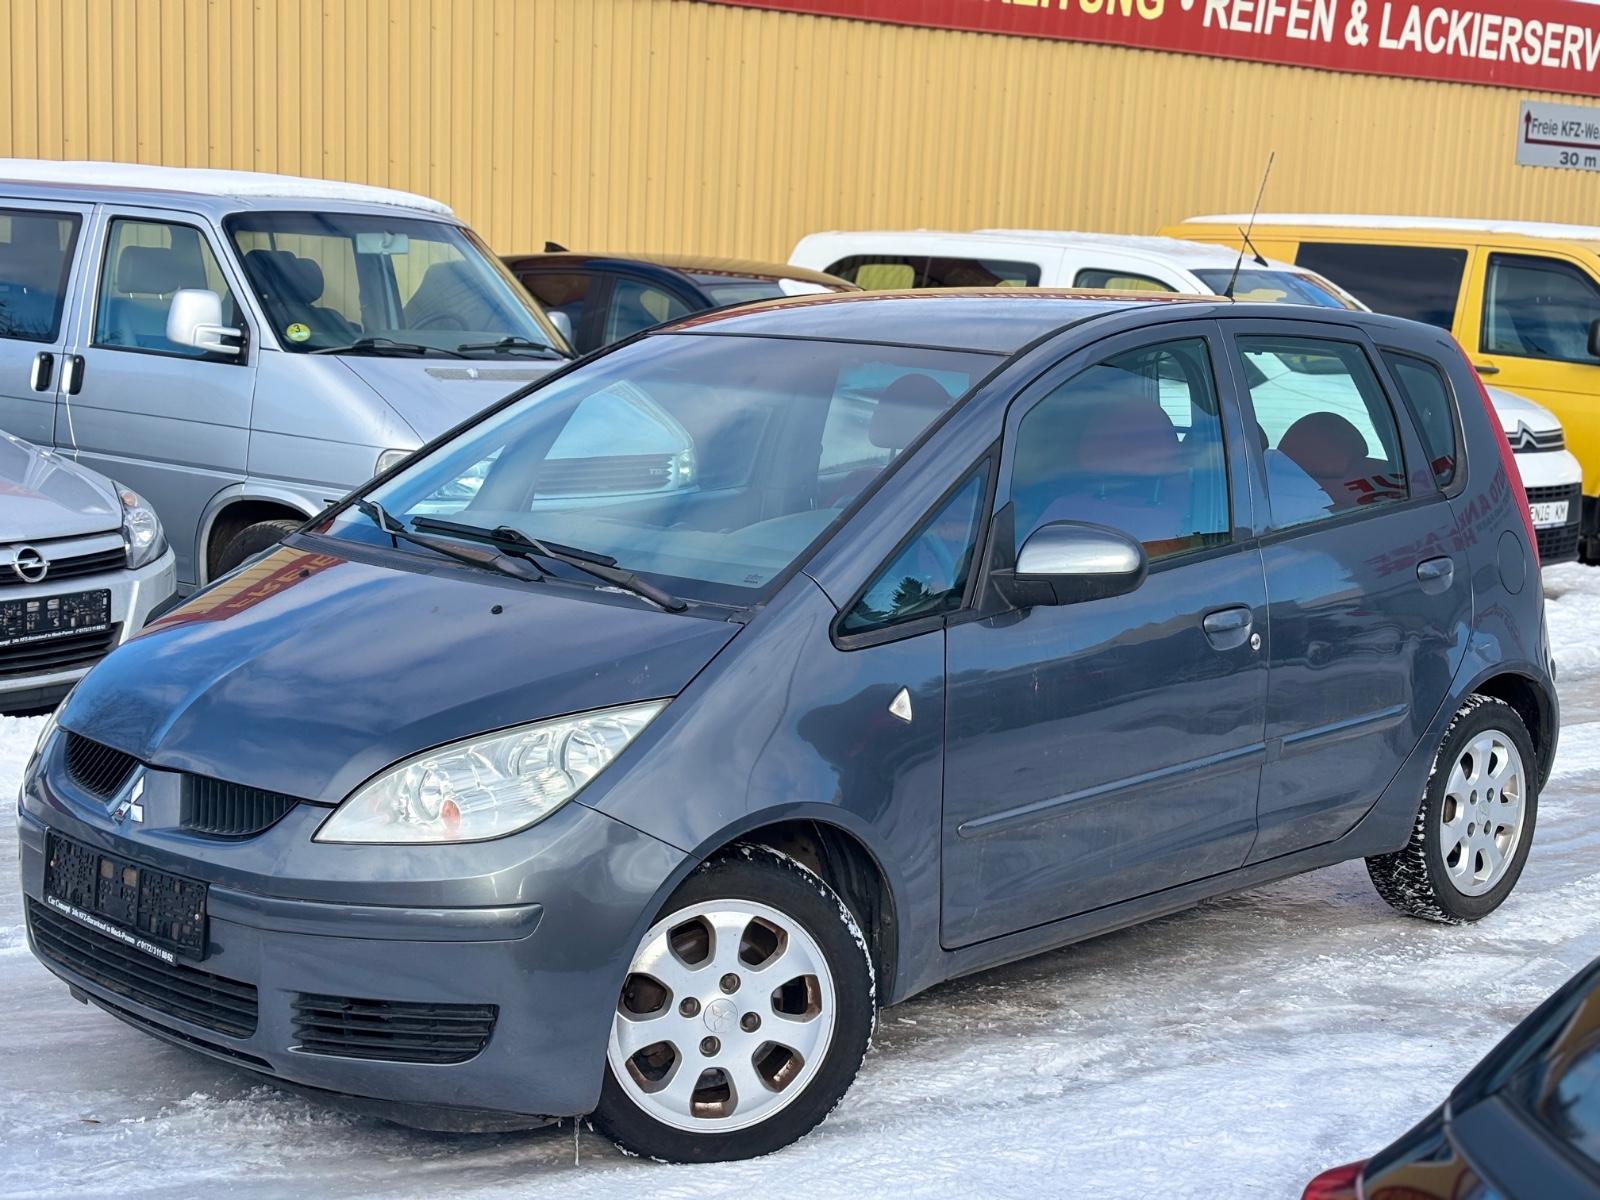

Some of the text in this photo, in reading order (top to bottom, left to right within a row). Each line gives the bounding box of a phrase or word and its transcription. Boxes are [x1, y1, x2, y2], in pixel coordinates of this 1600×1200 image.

[1203, 0, 1334, 43] REIFEN
[1378, 2, 1600, 72] LACKIERSERV
[1531, 117, 1558, 136] Freie
[1559, 151, 1597, 167] 30 m
